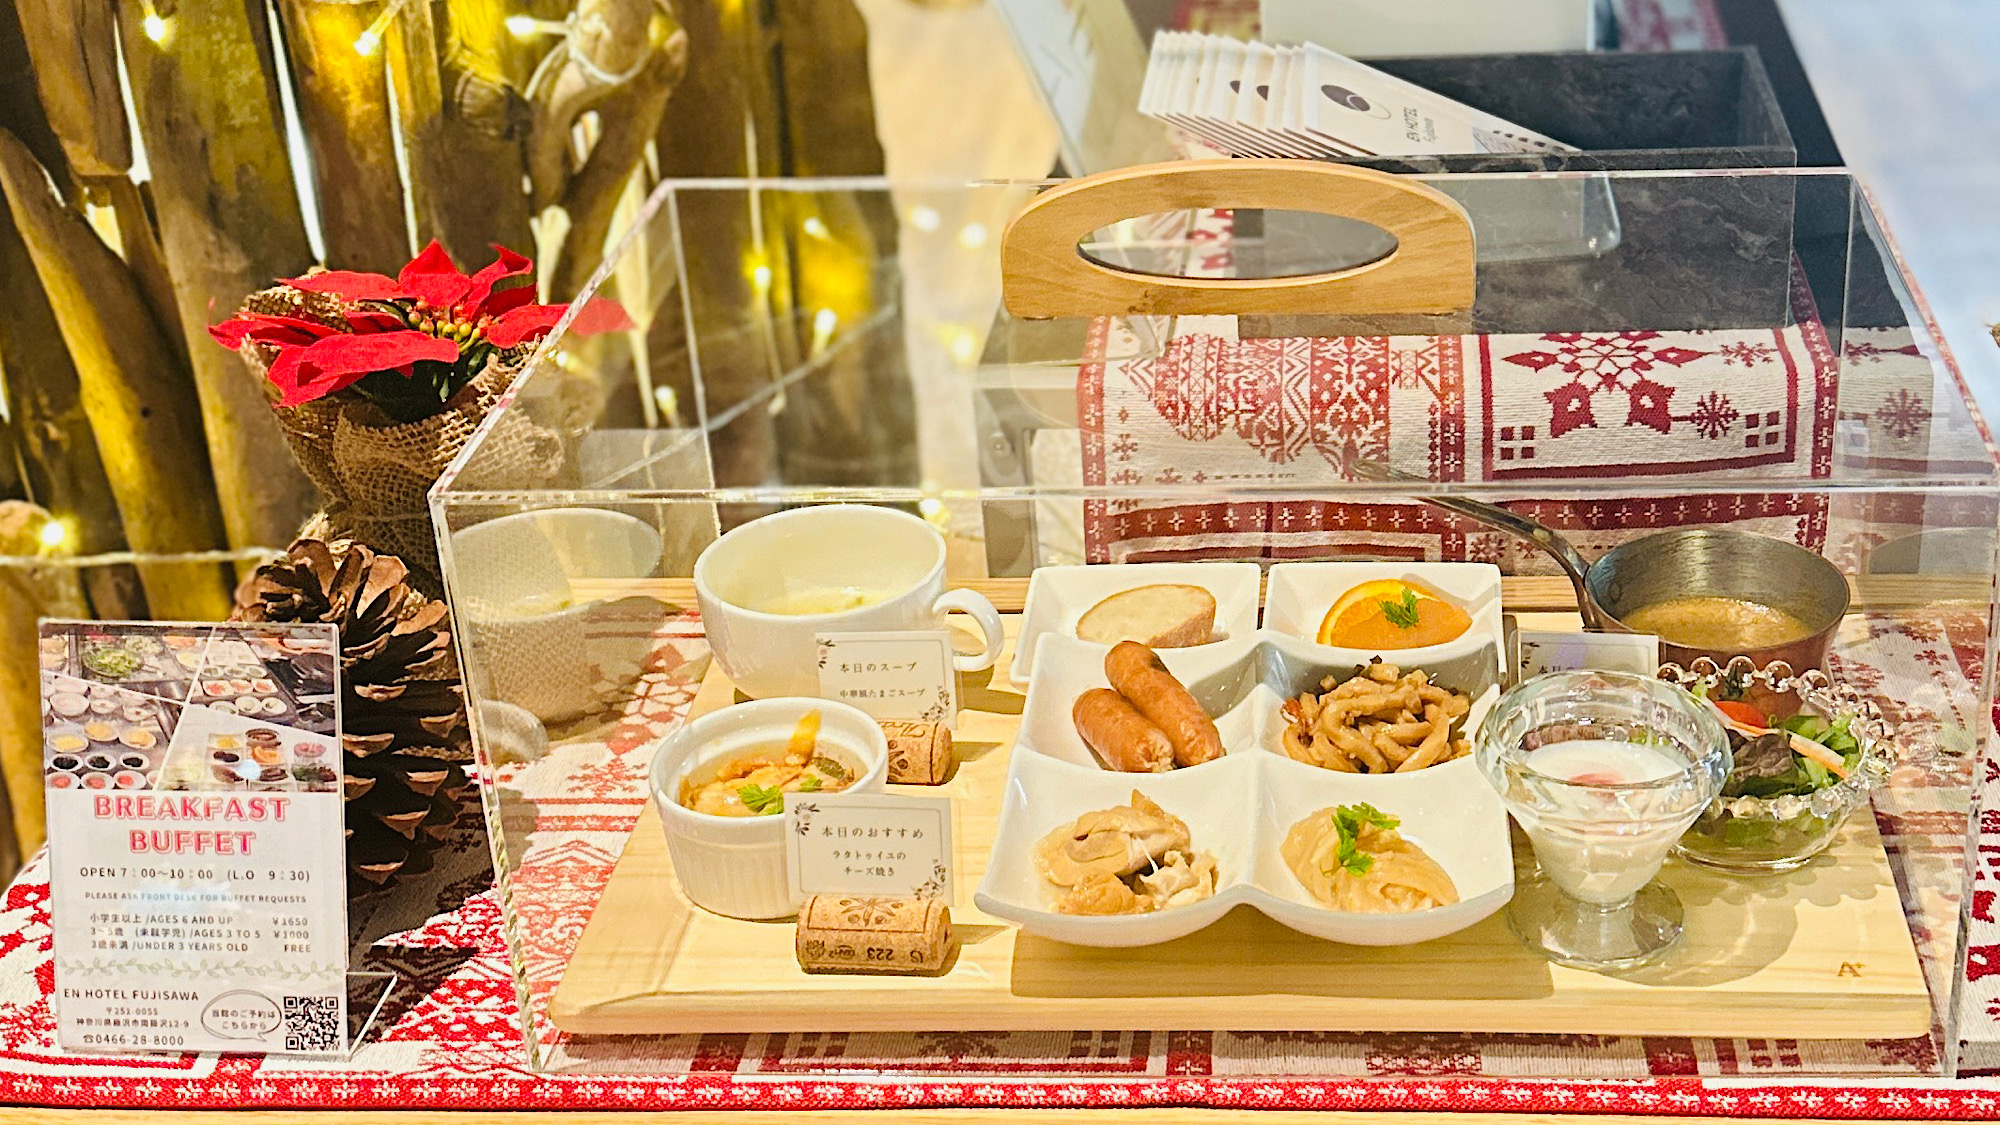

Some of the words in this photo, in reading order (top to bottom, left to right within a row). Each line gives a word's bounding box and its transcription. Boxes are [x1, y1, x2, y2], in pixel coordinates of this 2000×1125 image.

[840, 661, 917, 673] 本日のスープ
[840, 688, 926, 698] 中華風たまごスープ
[93, 794, 291, 822] BREAKFAST
[822, 826, 923, 838] 本日のおすすめ
[128, 829, 256, 855] BUFFET
[833, 850, 906, 860] ラタトゥイユの
[80, 867, 116, 878] OPEN
[844, 866, 895, 876] チーズ焼き
[85, 891, 118, 900] PLEASE
[121, 892, 139, 900] ASK
[141, 892, 171, 901] FRONT
[200, 893, 219, 901] FOR
[221, 894, 255, 902] BUFFET
[258, 895, 307, 903] REQUESTS
[90, 913, 142, 923] 小学生以上
[191, 915, 215, 925] AND
[218, 916, 234, 925] UP
[236, 930, 251, 938] TO
[188, 942, 223, 951] YEARS
[226, 943, 249, 952] OLD
[284, 943, 312, 953] FREE
[64, 988, 80, 998] EN
[85, 989, 128, 999] HOTEL
[132, 990, 199, 1001] FUJISAWA
[222, 1021, 267, 1030] こちらから
